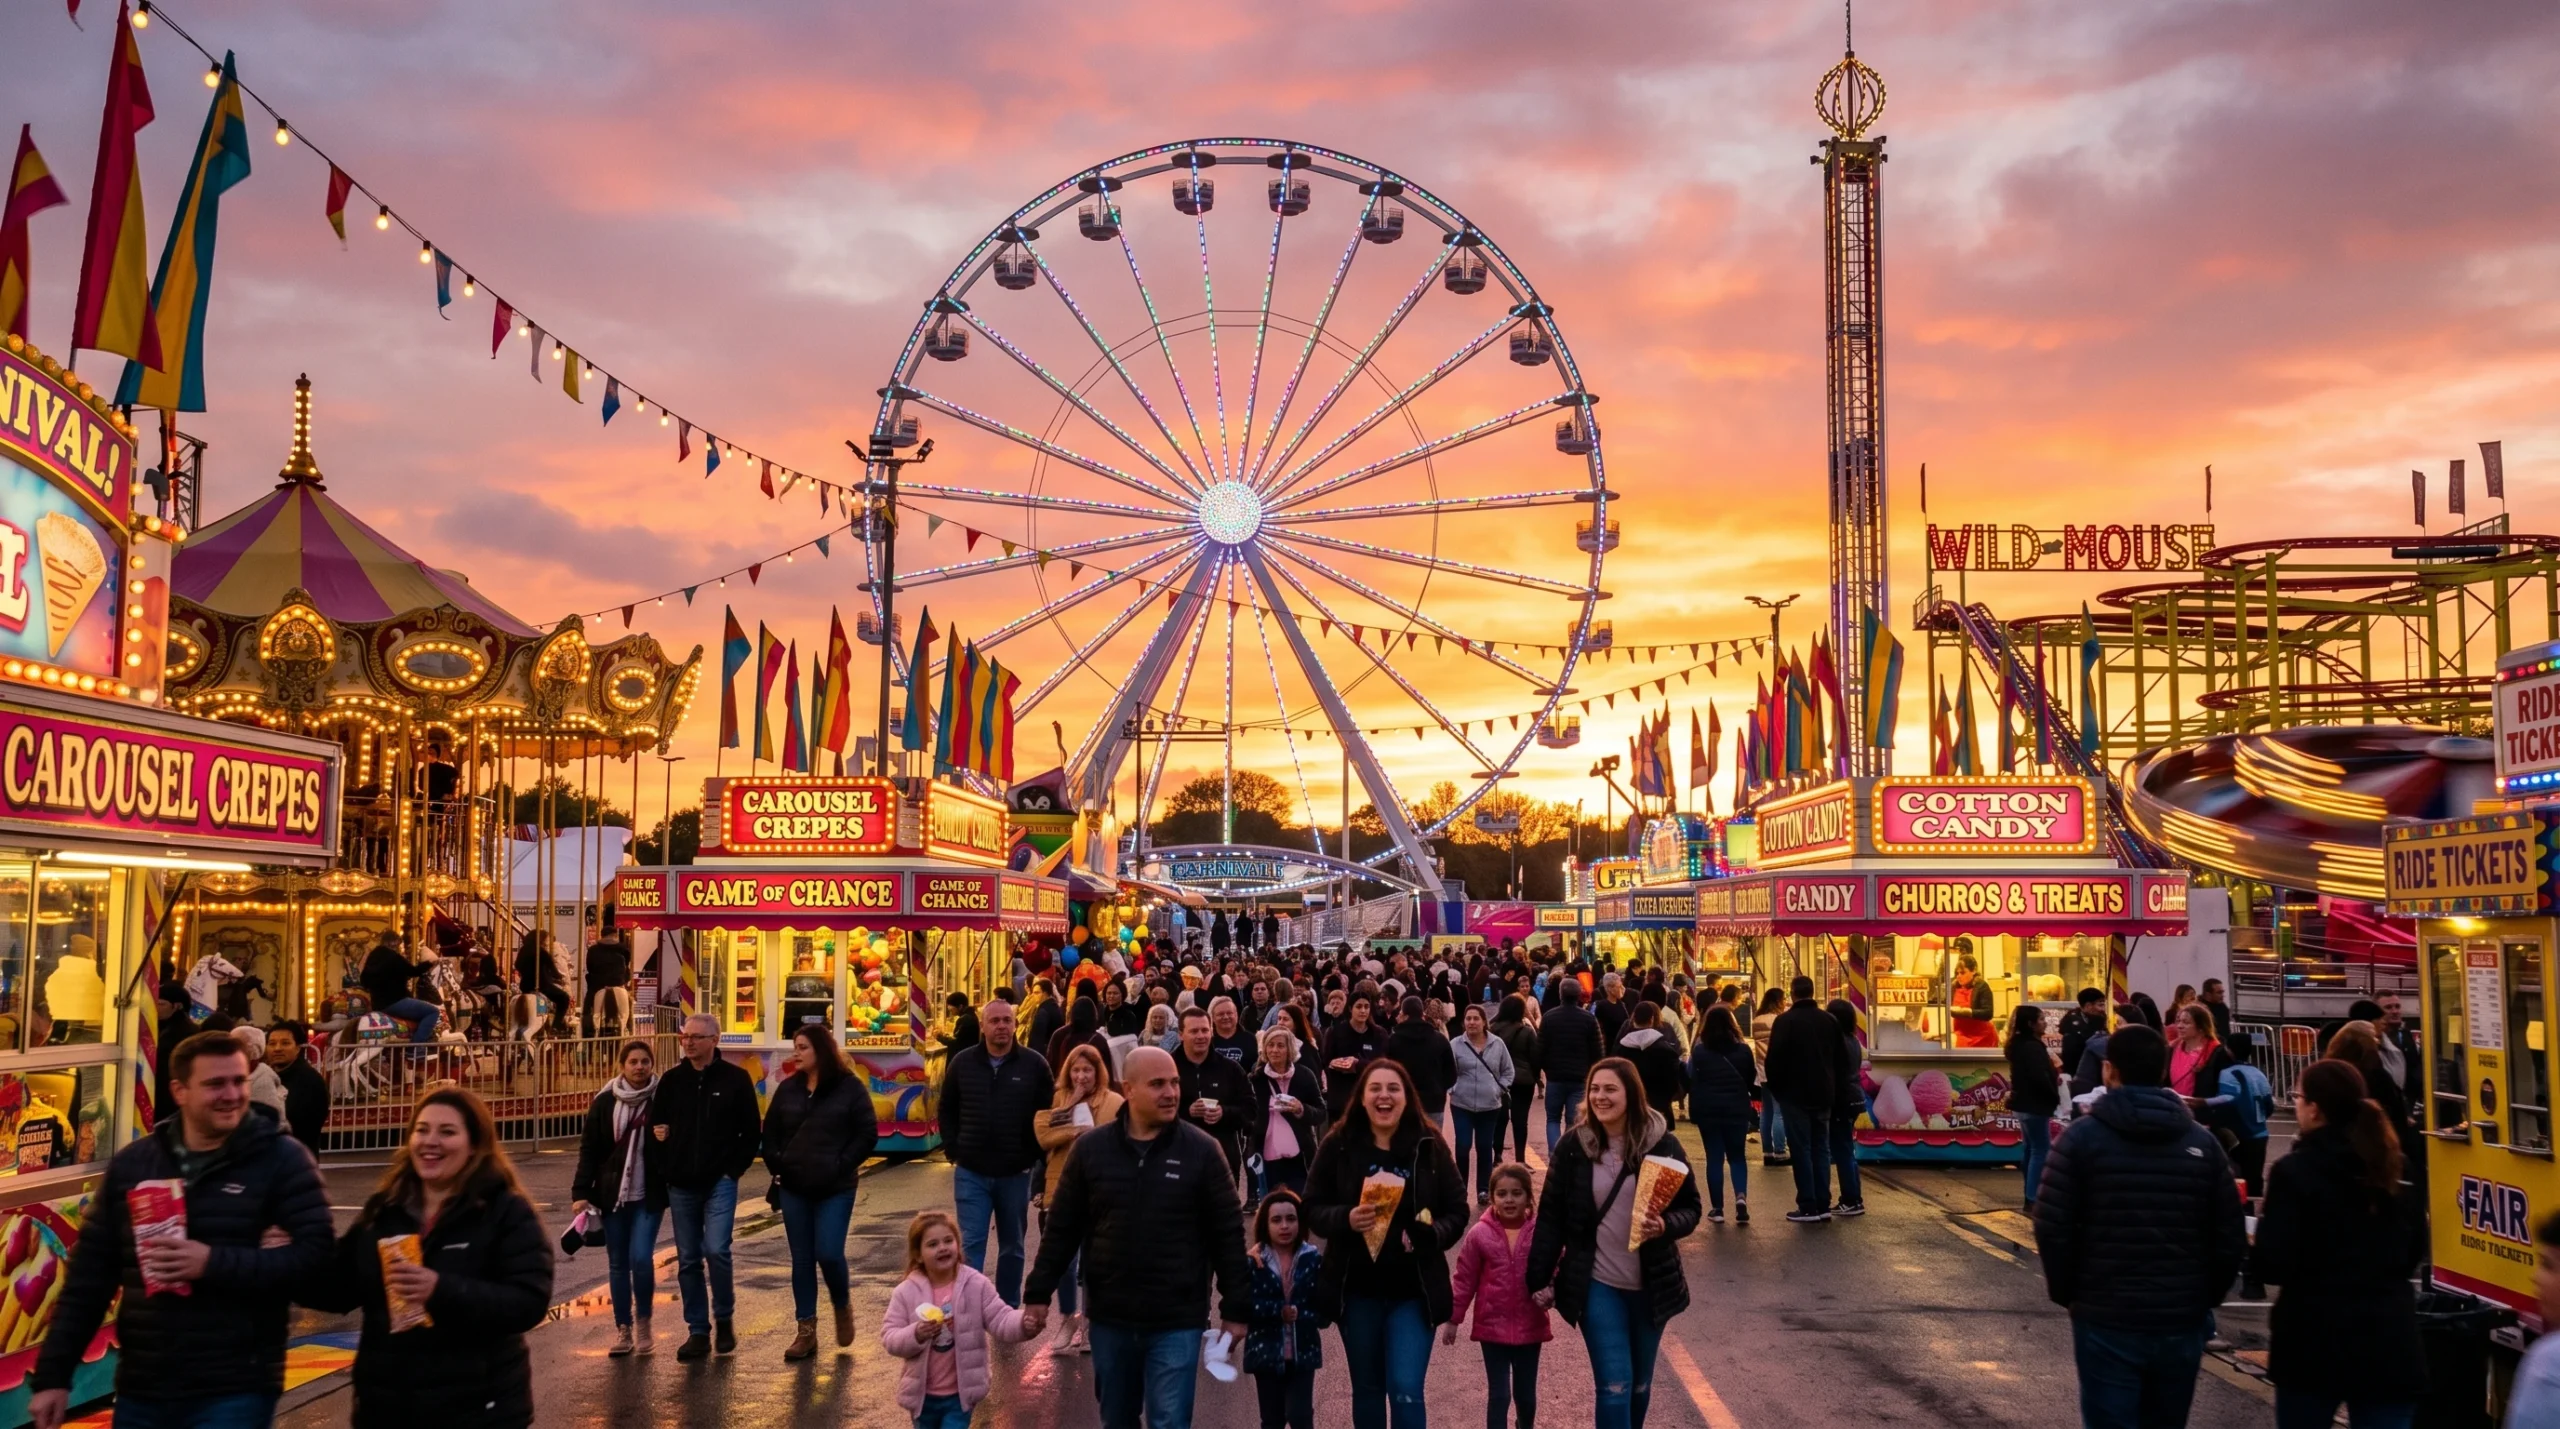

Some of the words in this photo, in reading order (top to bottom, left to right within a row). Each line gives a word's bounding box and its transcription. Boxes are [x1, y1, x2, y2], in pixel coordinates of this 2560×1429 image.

[1928, 524, 2041, 570] WILD
[2064, 524, 2215, 570] MOUSE
[4, 725, 198, 818] CAROUSEL
[208, 756, 321, 834] CREPES
[742, 790, 878, 814] CAROUSEL
[1898, 792, 2069, 814] COTTON
[753, 815, 864, 840] CREPES
[1764, 810, 1803, 853] COTTON
[1805, 799, 1845, 845] CANDY
[1911, 816, 2057, 839] CANDY
[2394, 848, 2437, 890] RIDE
[2442, 838, 2528, 887] TICKETS
[619, 891, 661, 907] CHANCE
[686, 880, 758, 907] GAME
[763, 886, 785, 902] OF
[789, 880, 894, 907] CHANCE
[929, 880, 965, 892] GAME
[967, 881, 982, 892] OF
[1786, 885, 1856, 912] CANDY
[1885, 883, 2001, 914] CHURROS
[2007, 883, 2026, 913] &
[2032, 884, 2124, 913] TREATS
[921, 893, 989, 909] CHANCE
[2461, 1176, 2531, 1245] FAIR
